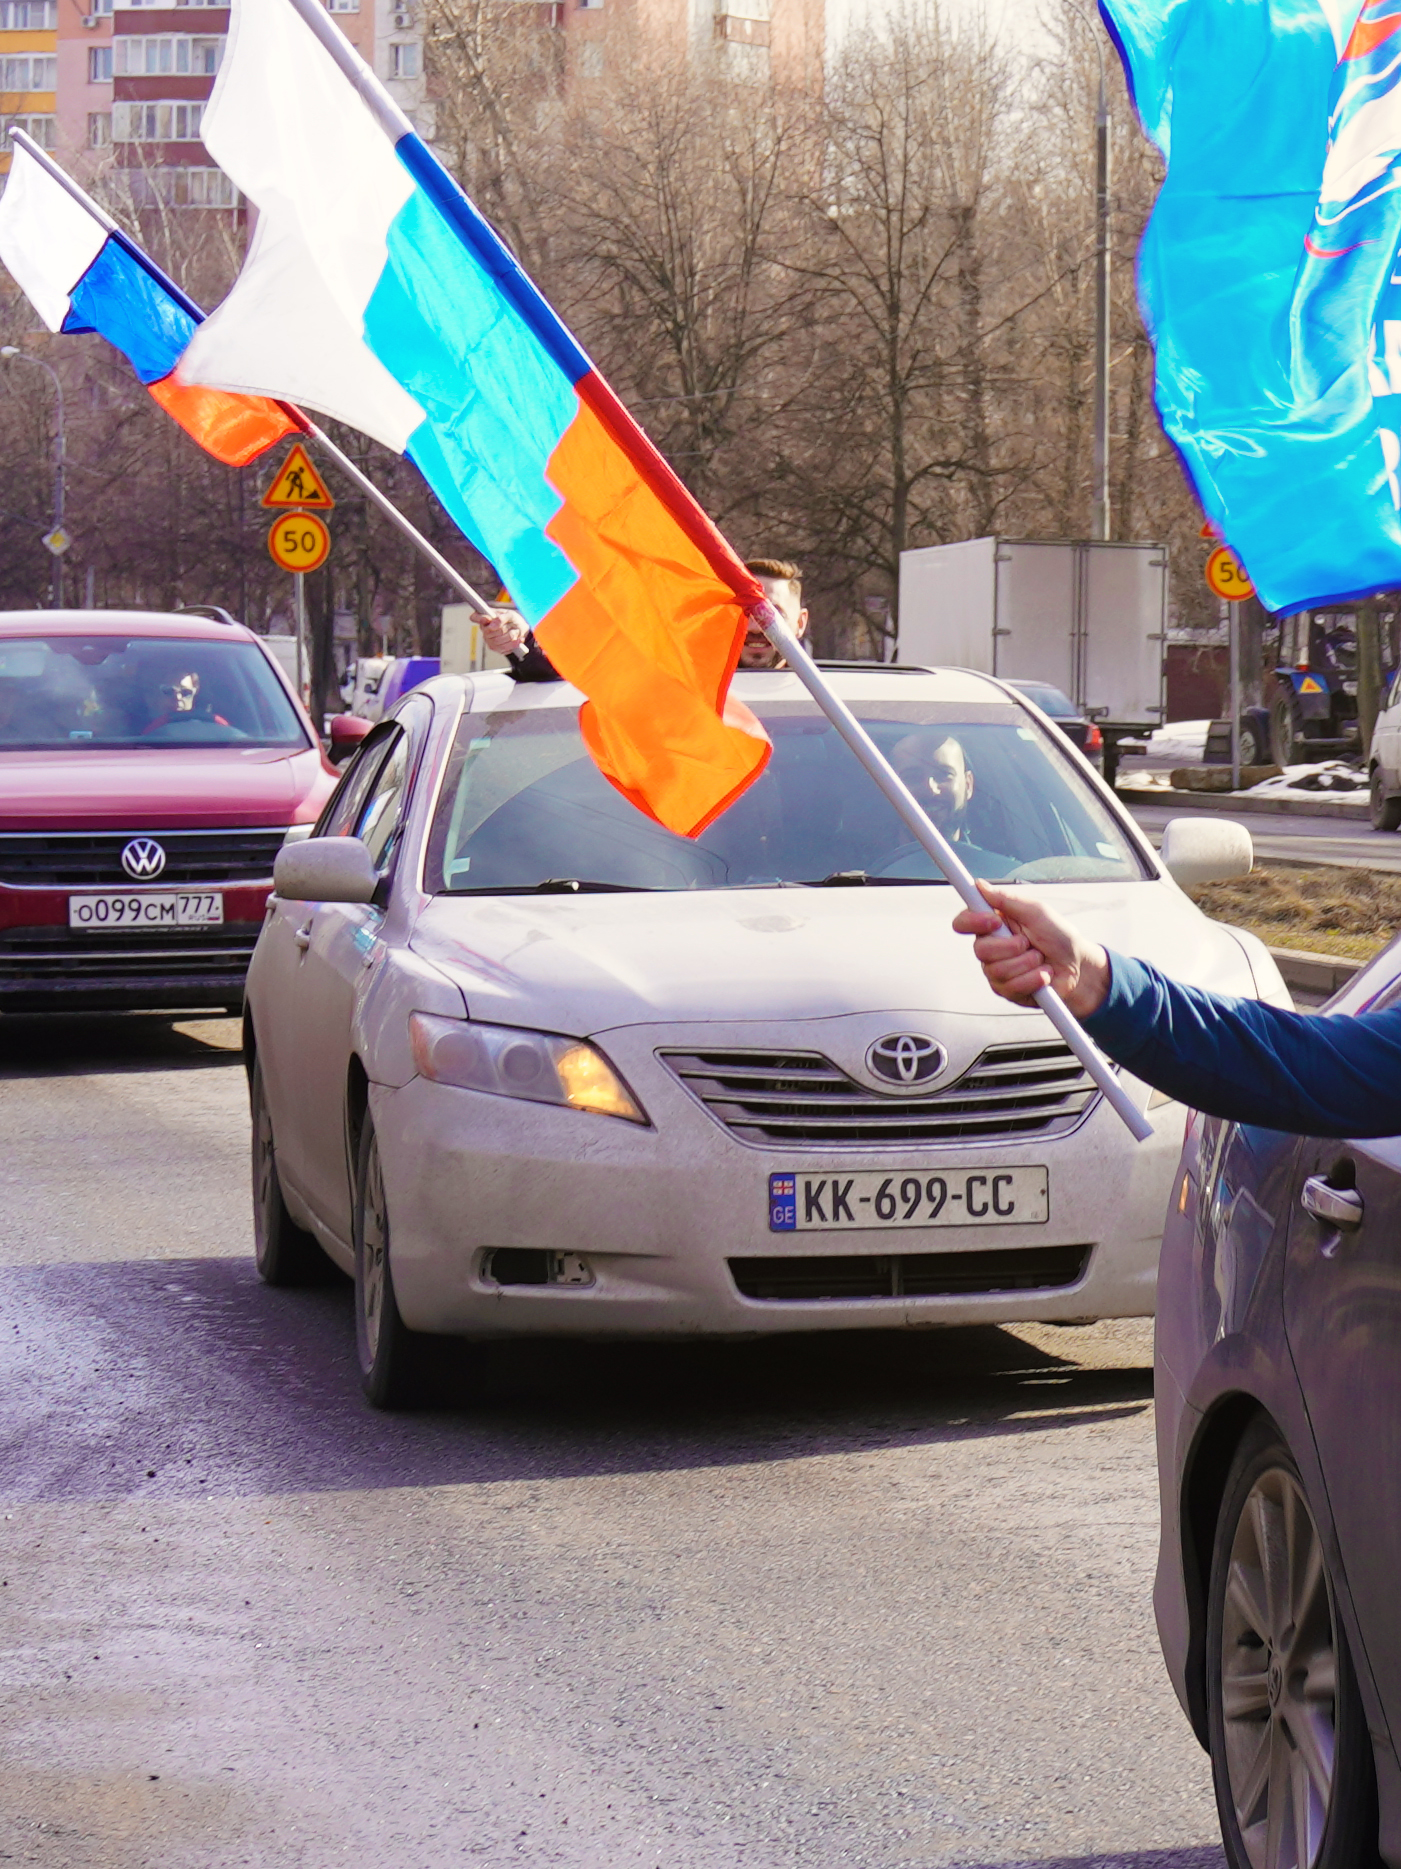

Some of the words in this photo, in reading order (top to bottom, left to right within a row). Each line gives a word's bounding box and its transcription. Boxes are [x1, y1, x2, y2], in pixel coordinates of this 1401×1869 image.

[283, 530, 316, 553] 50
[78, 898, 175, 922] О099СМ
[179, 896, 215, 914] 777
[804, 1174, 1015, 1222] KK-699-CC
[773, 1206, 794, 1224] GE
